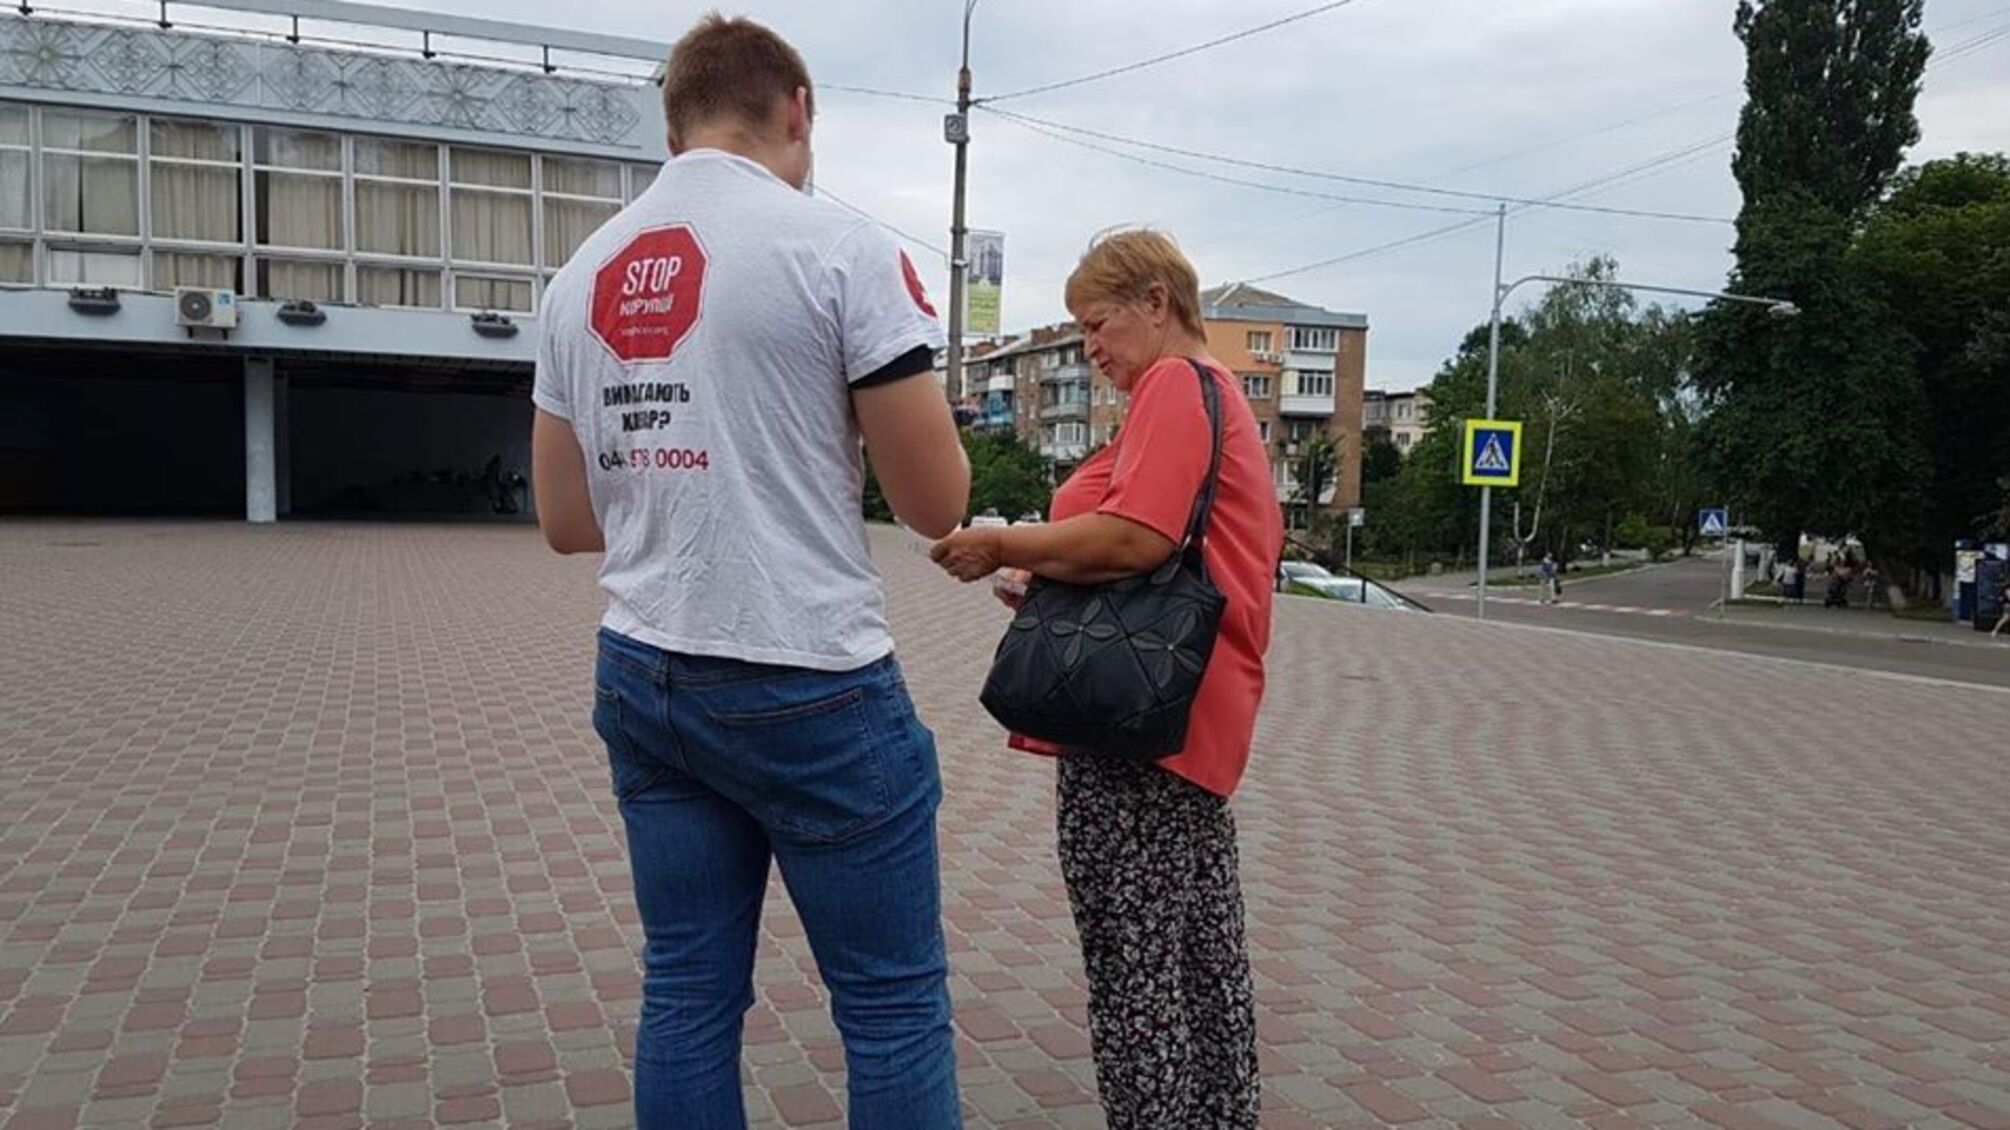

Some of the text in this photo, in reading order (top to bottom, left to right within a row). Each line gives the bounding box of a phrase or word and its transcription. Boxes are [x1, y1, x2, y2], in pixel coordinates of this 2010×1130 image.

[623, 256, 682, 295] STOP
[603, 382, 690, 407] ВИМГАЮТЬ
[655, 448, 709, 470] 0004
